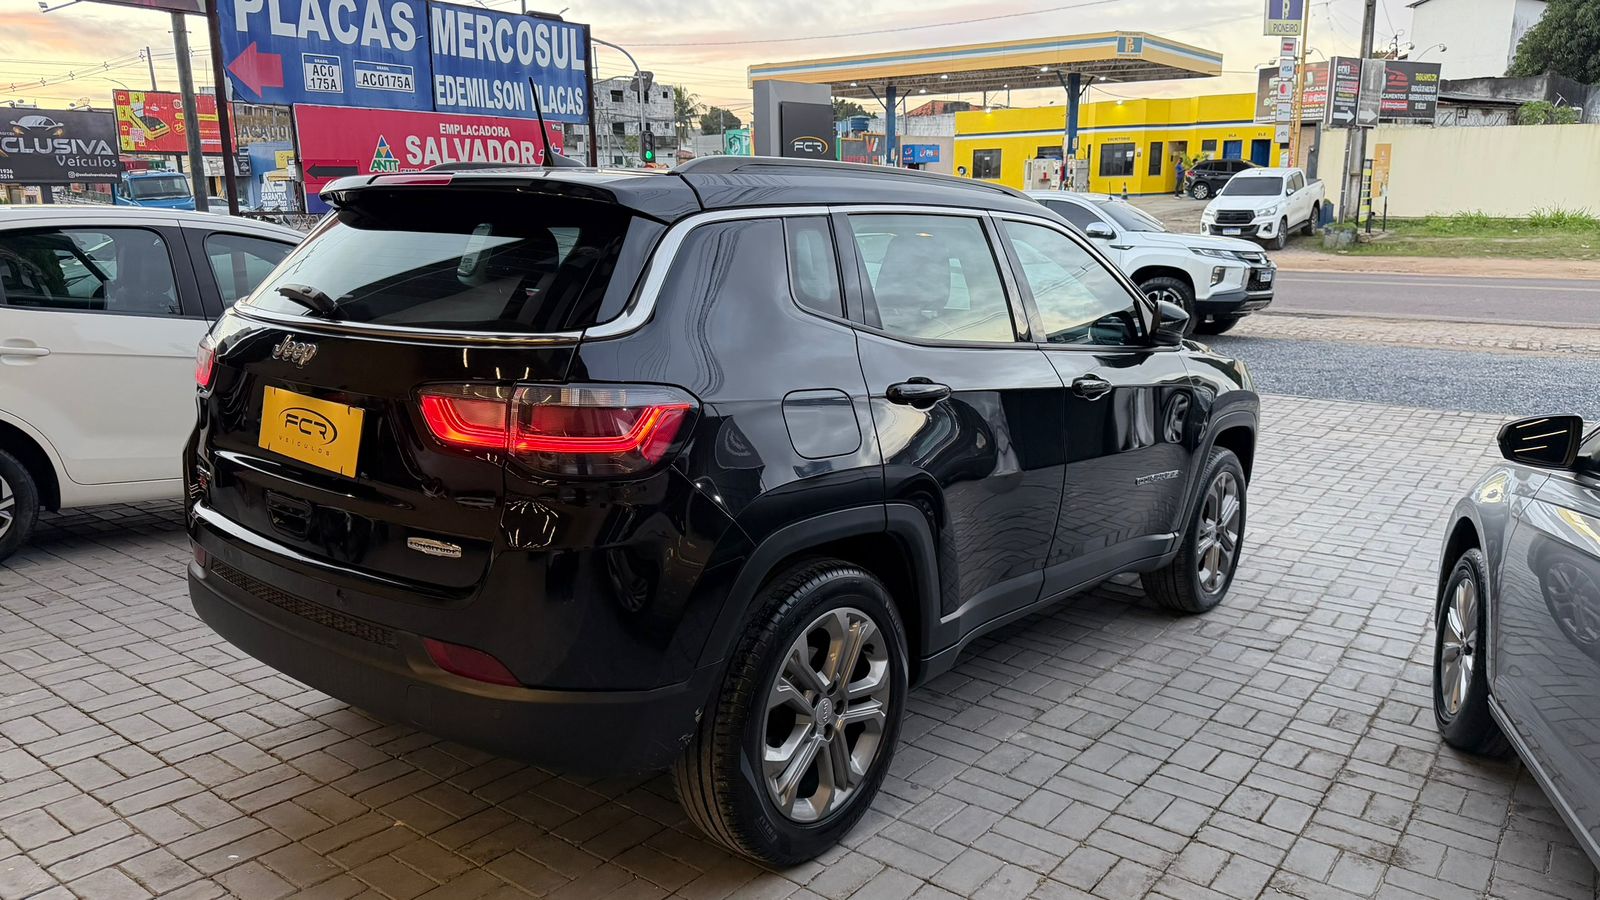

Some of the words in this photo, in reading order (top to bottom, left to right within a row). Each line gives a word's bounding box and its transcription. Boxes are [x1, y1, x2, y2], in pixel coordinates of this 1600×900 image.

[234, 0, 417, 51] PLACAS
[431, 7, 586, 71] MERCOSUL
[1272, 23, 1298, 33] PIONEIRO
[311, 77, 337, 90] 175A
[435, 75, 526, 111] EDEMILSON
[439, 123, 511, 138] EMPLACADORA
[0, 137, 114, 154] CLUSIVA
[406, 135, 536, 167] SALVADOR
[794, 142, 823, 152] FCR
[56, 155, 117, 168] Veículos
[370, 159, 400, 173] ANTT
[261, 192, 287, 200] GARANTIA
[272, 334, 319, 369] Jeep
[285, 413, 328, 440] FCR
